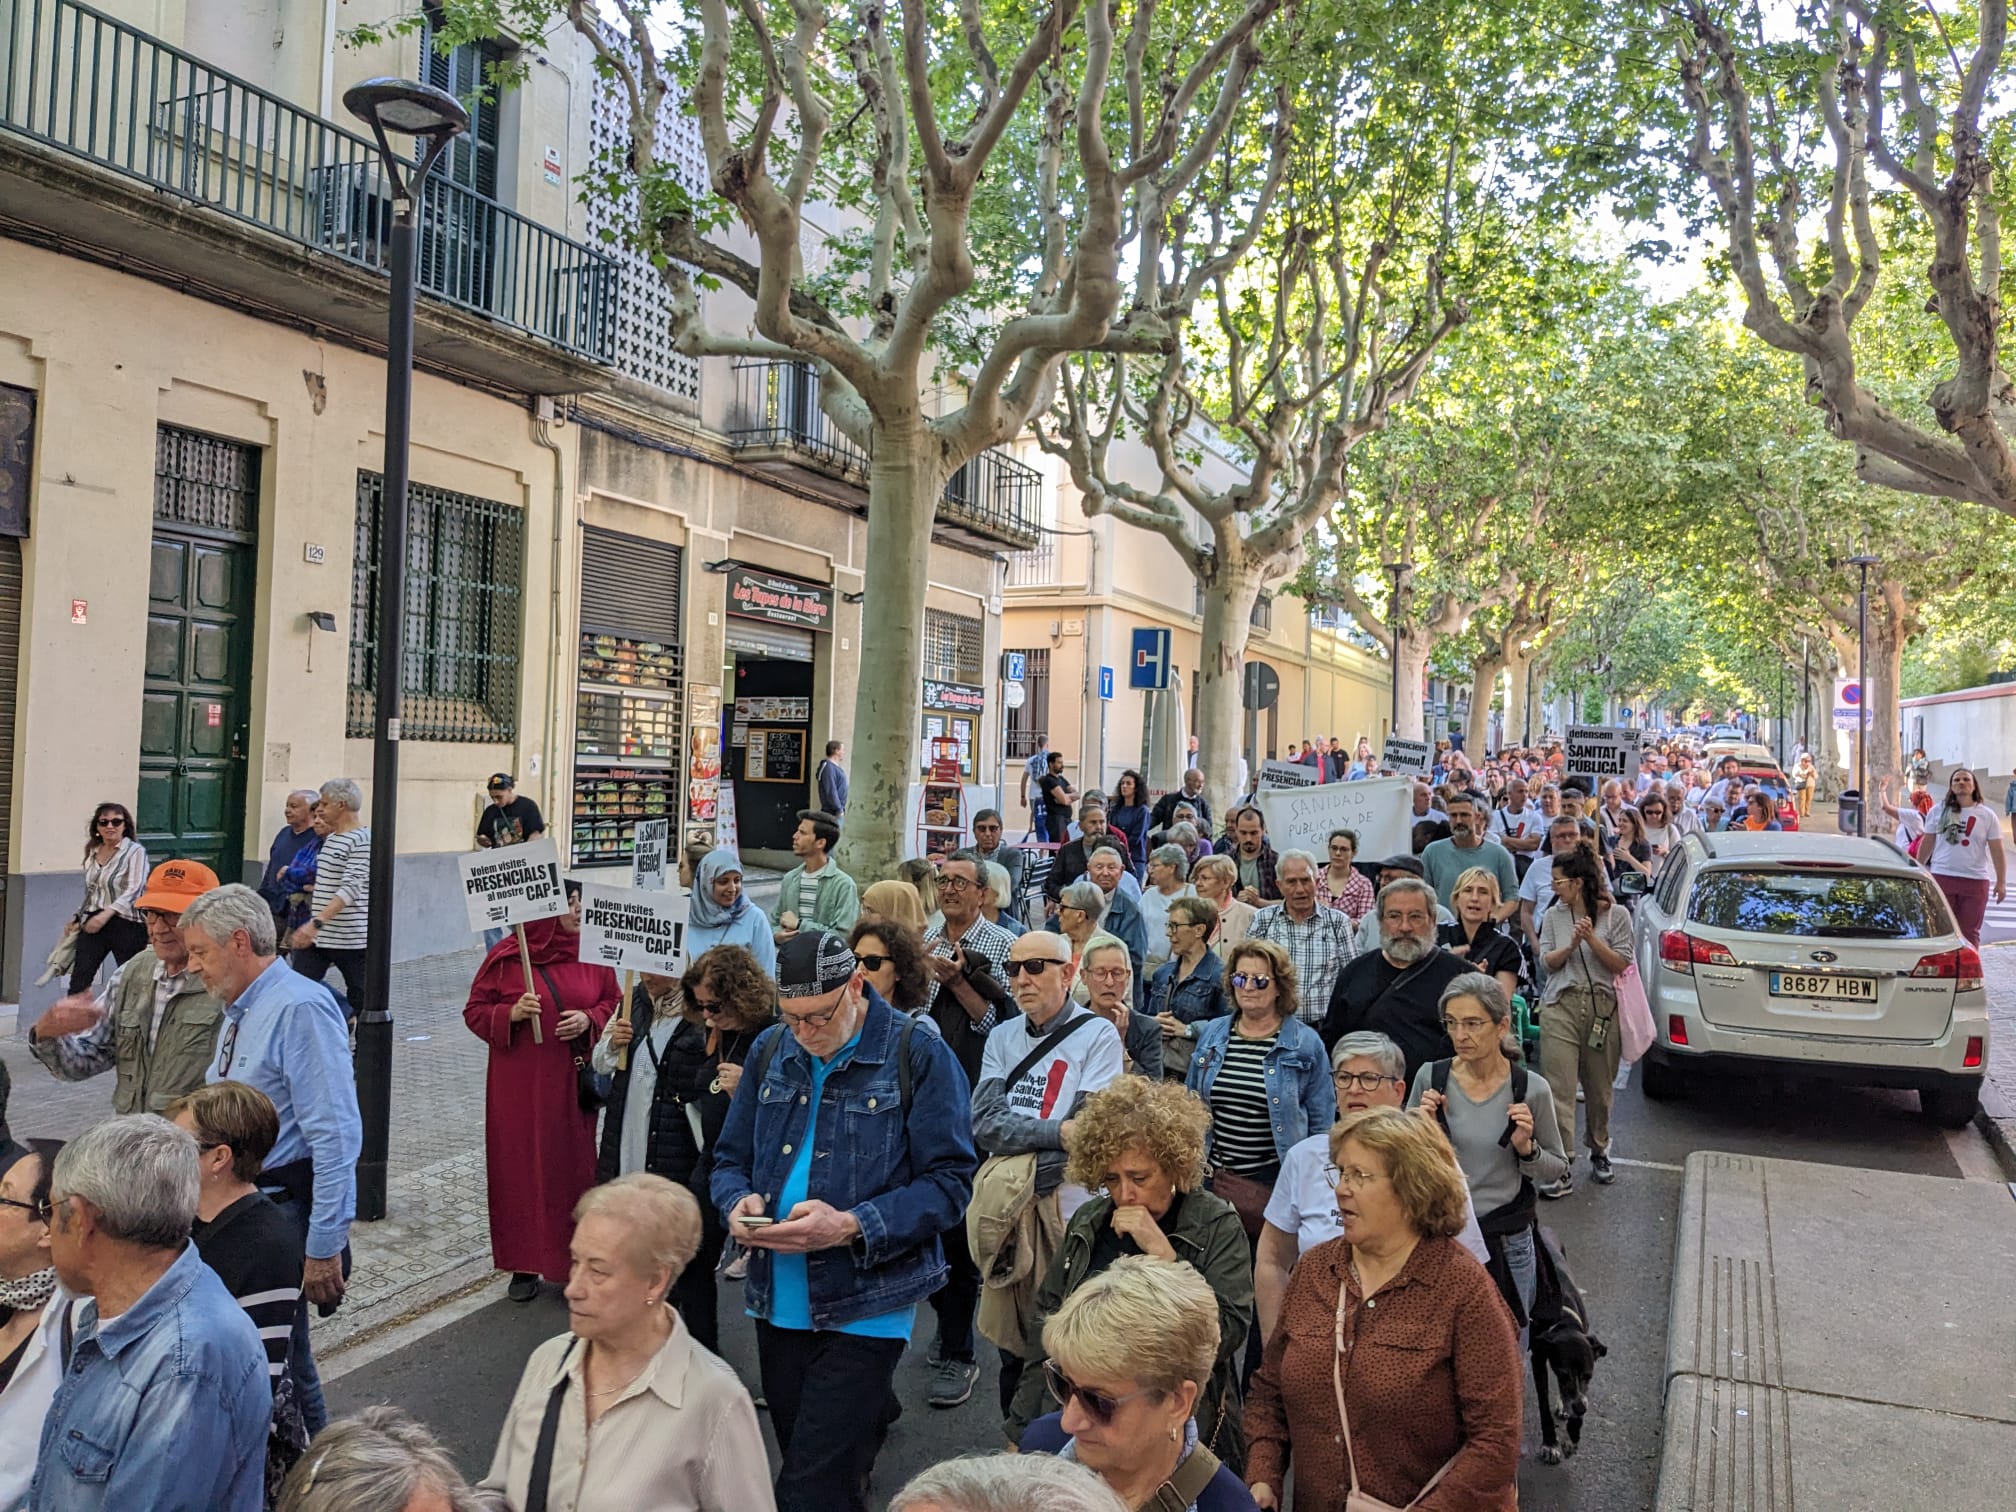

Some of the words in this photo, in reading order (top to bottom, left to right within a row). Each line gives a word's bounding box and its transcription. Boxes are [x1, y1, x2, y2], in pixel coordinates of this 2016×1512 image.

[309, 546, 324, 560] 129
[733, 582, 751, 601] Les
[780, 593, 792, 610] de
[766, 610, 797, 622] Restaurant
[1569, 728, 1613, 740] defensem
[1385, 739, 1428, 753] potenciem
[1568, 744, 1618, 759] SANITAT
[1261, 771, 1310, 787] PRESENCIALS
[1291, 791, 1365, 821] SANIDAD
[1288, 818, 1336, 838] PUBLICA
[1342, 816, 1350, 827] Y
[1358, 811, 1374, 825] DE
[470, 864, 498, 877] Volem
[498, 858, 528, 872] visites
[466, 864, 547, 895] PRESENCIALS
[487, 891, 496, 902] al
[496, 886, 525, 900] nostre
[593, 898, 622, 912] Volem
[623, 902, 655, 917] visites
[585, 908, 672, 937] PRESENCIALS
[604, 929, 613, 939] al
[614, 931, 645, 944] nostre
[1783, 976, 1830, 993] 8687
[1836, 979, 1872, 997] HBW
[1011, 1094, 1043, 1110] pública
